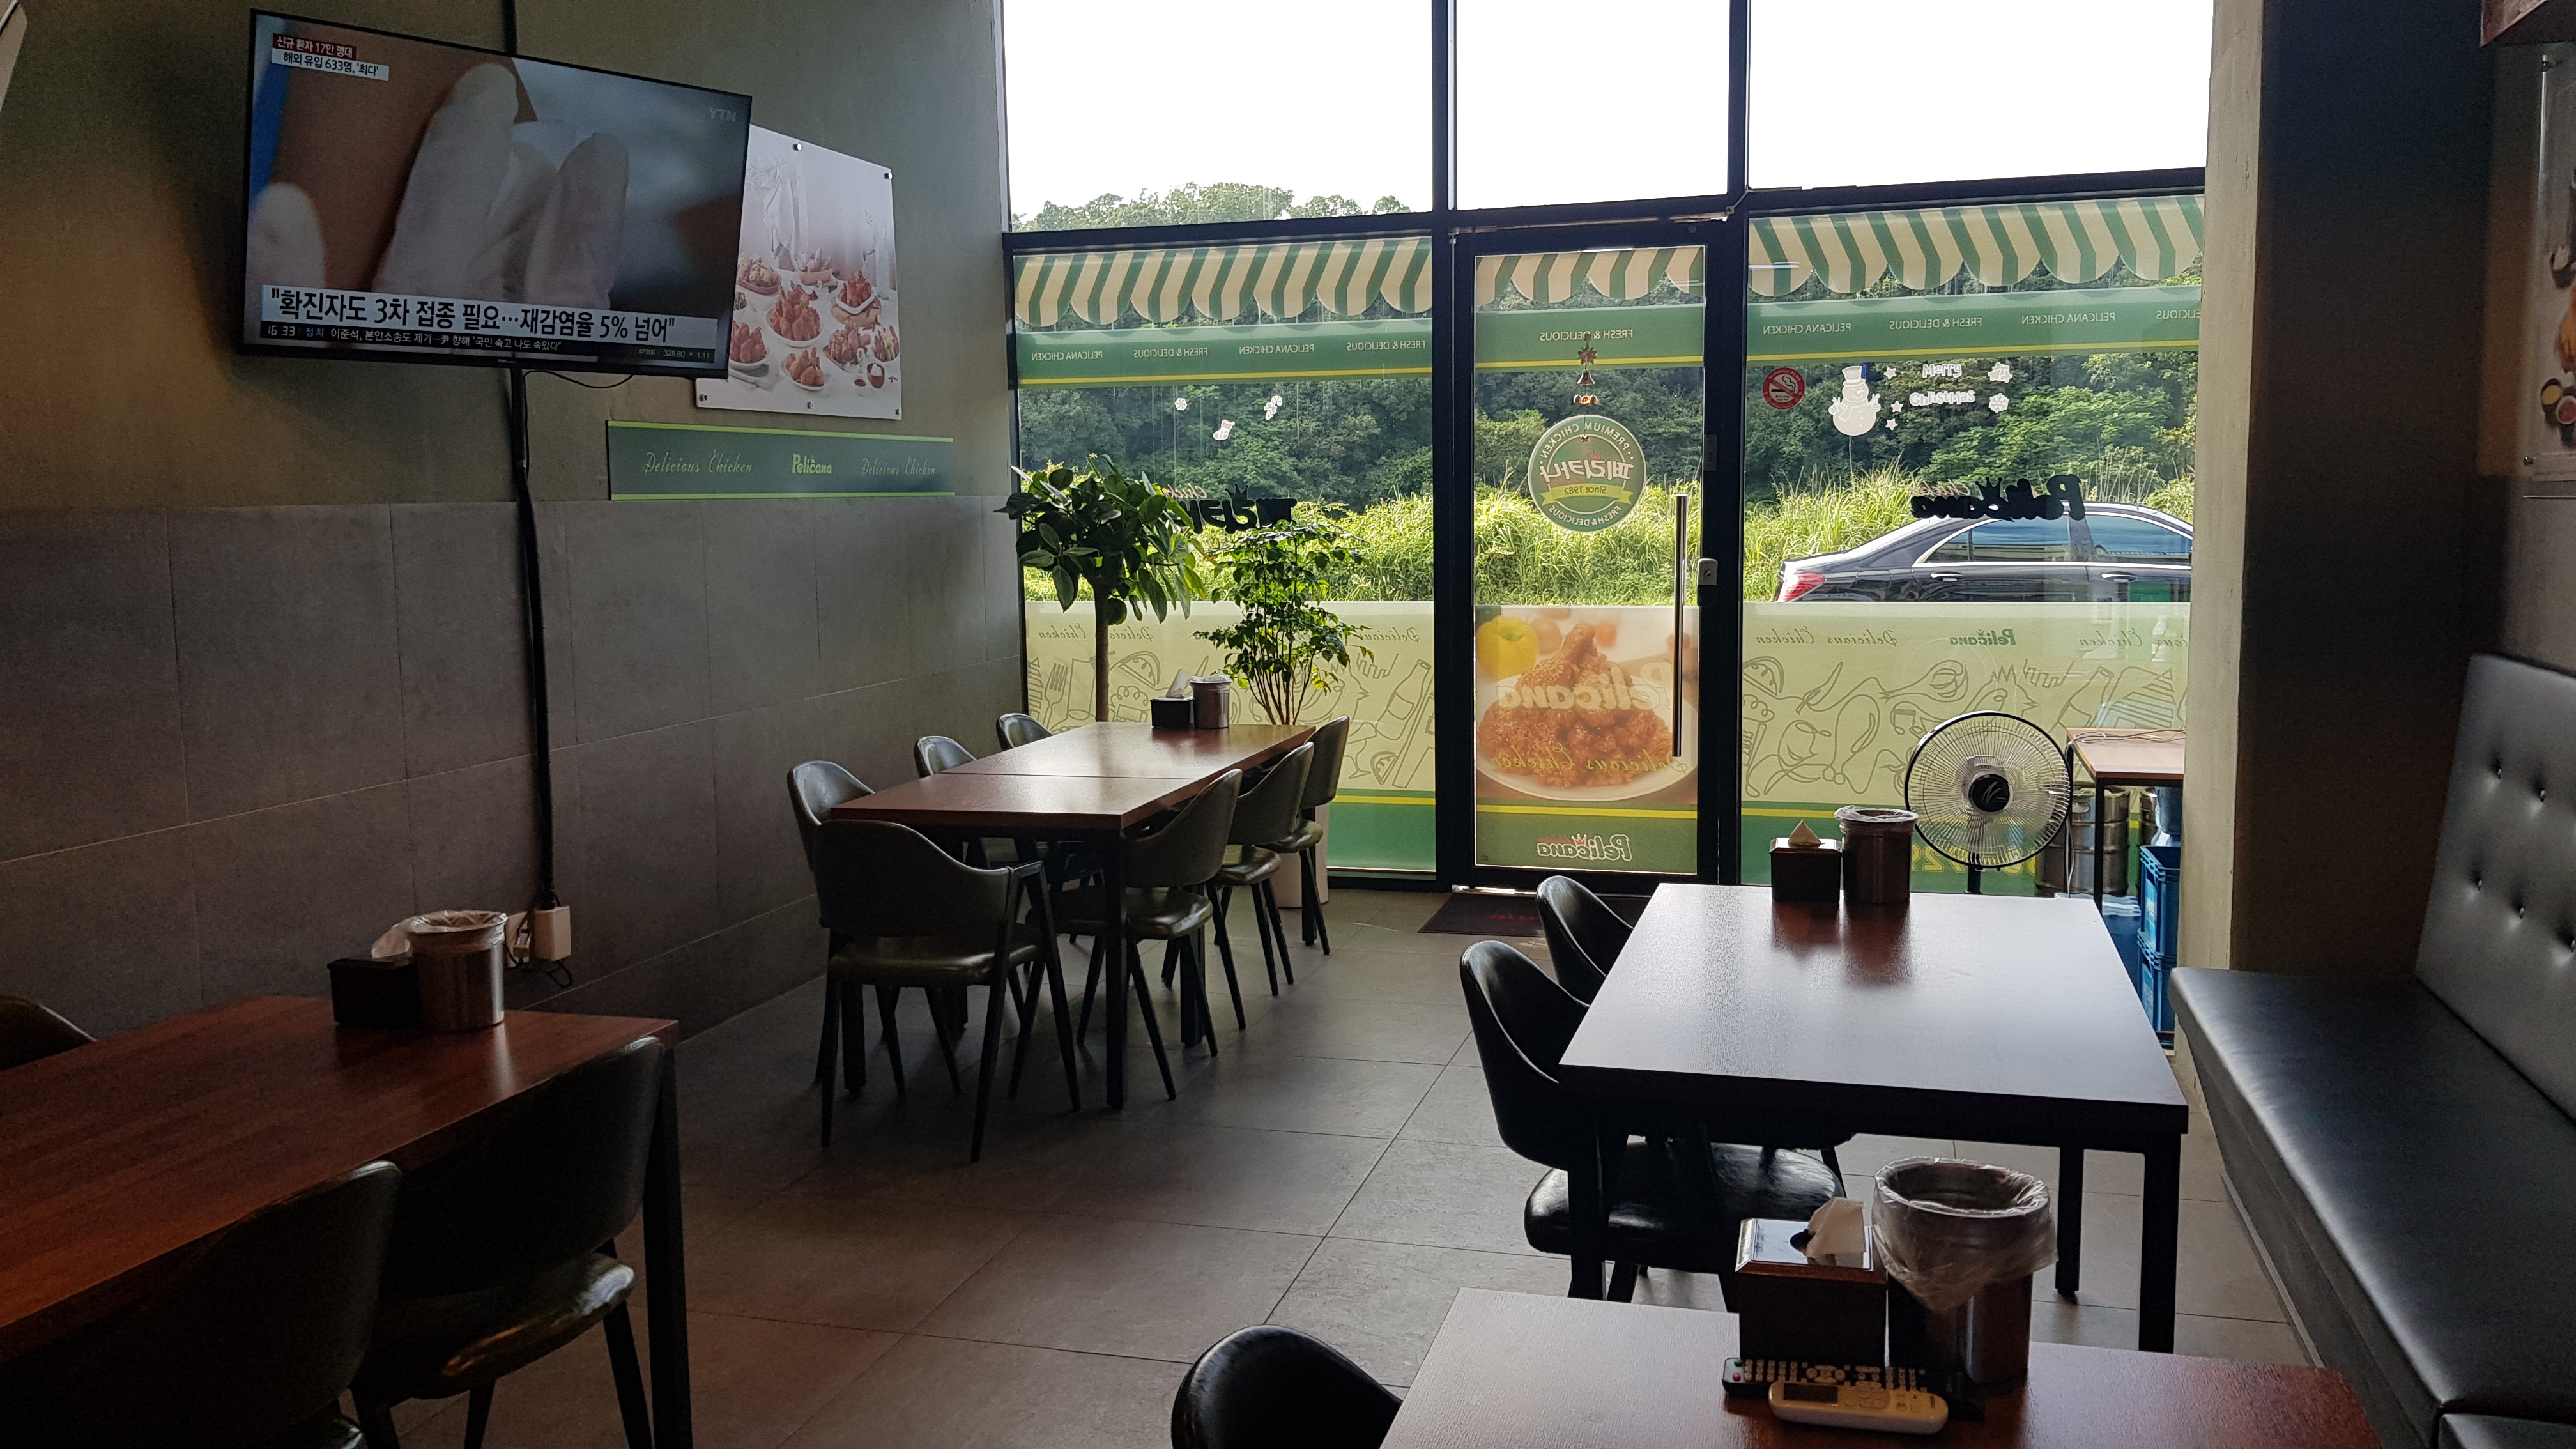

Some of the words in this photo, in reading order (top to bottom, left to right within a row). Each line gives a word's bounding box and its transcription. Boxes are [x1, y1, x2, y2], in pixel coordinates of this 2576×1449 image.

[277, 36, 295, 49] 신규
[296, 38, 314, 52] 환자
[316, 43, 335, 56] 17만
[336, 46, 353, 58] 명대
[283, 52, 302, 65] 해외
[304, 56, 323, 69] 유입
[325, 59, 355, 74] 633명,
[709, 107, 737, 122] YTN
[272, 288, 367, 322] "확진자도
[374, 298, 410, 326] 3차
[416, 301, 456, 329] 접종
[599, 316, 628, 339] 5%
[635, 317, 675, 343] 넘어"
[330, 328, 362, 342] 이준석,
[365, 330, 411, 343] 본안소송도
[452, 335, 470, 346] 향해
[494, 337, 512, 349] 속고
[514, 339, 532, 349] 나도
[1922, 364, 1962, 378] Merry
[644, 451, 700, 475] Delicious
[709, 448, 753, 473] Chicken
[792, 453, 832, 474] Pelicana
[861, 457, 900, 477] Delicious
[905, 454, 936, 475] Chicken
